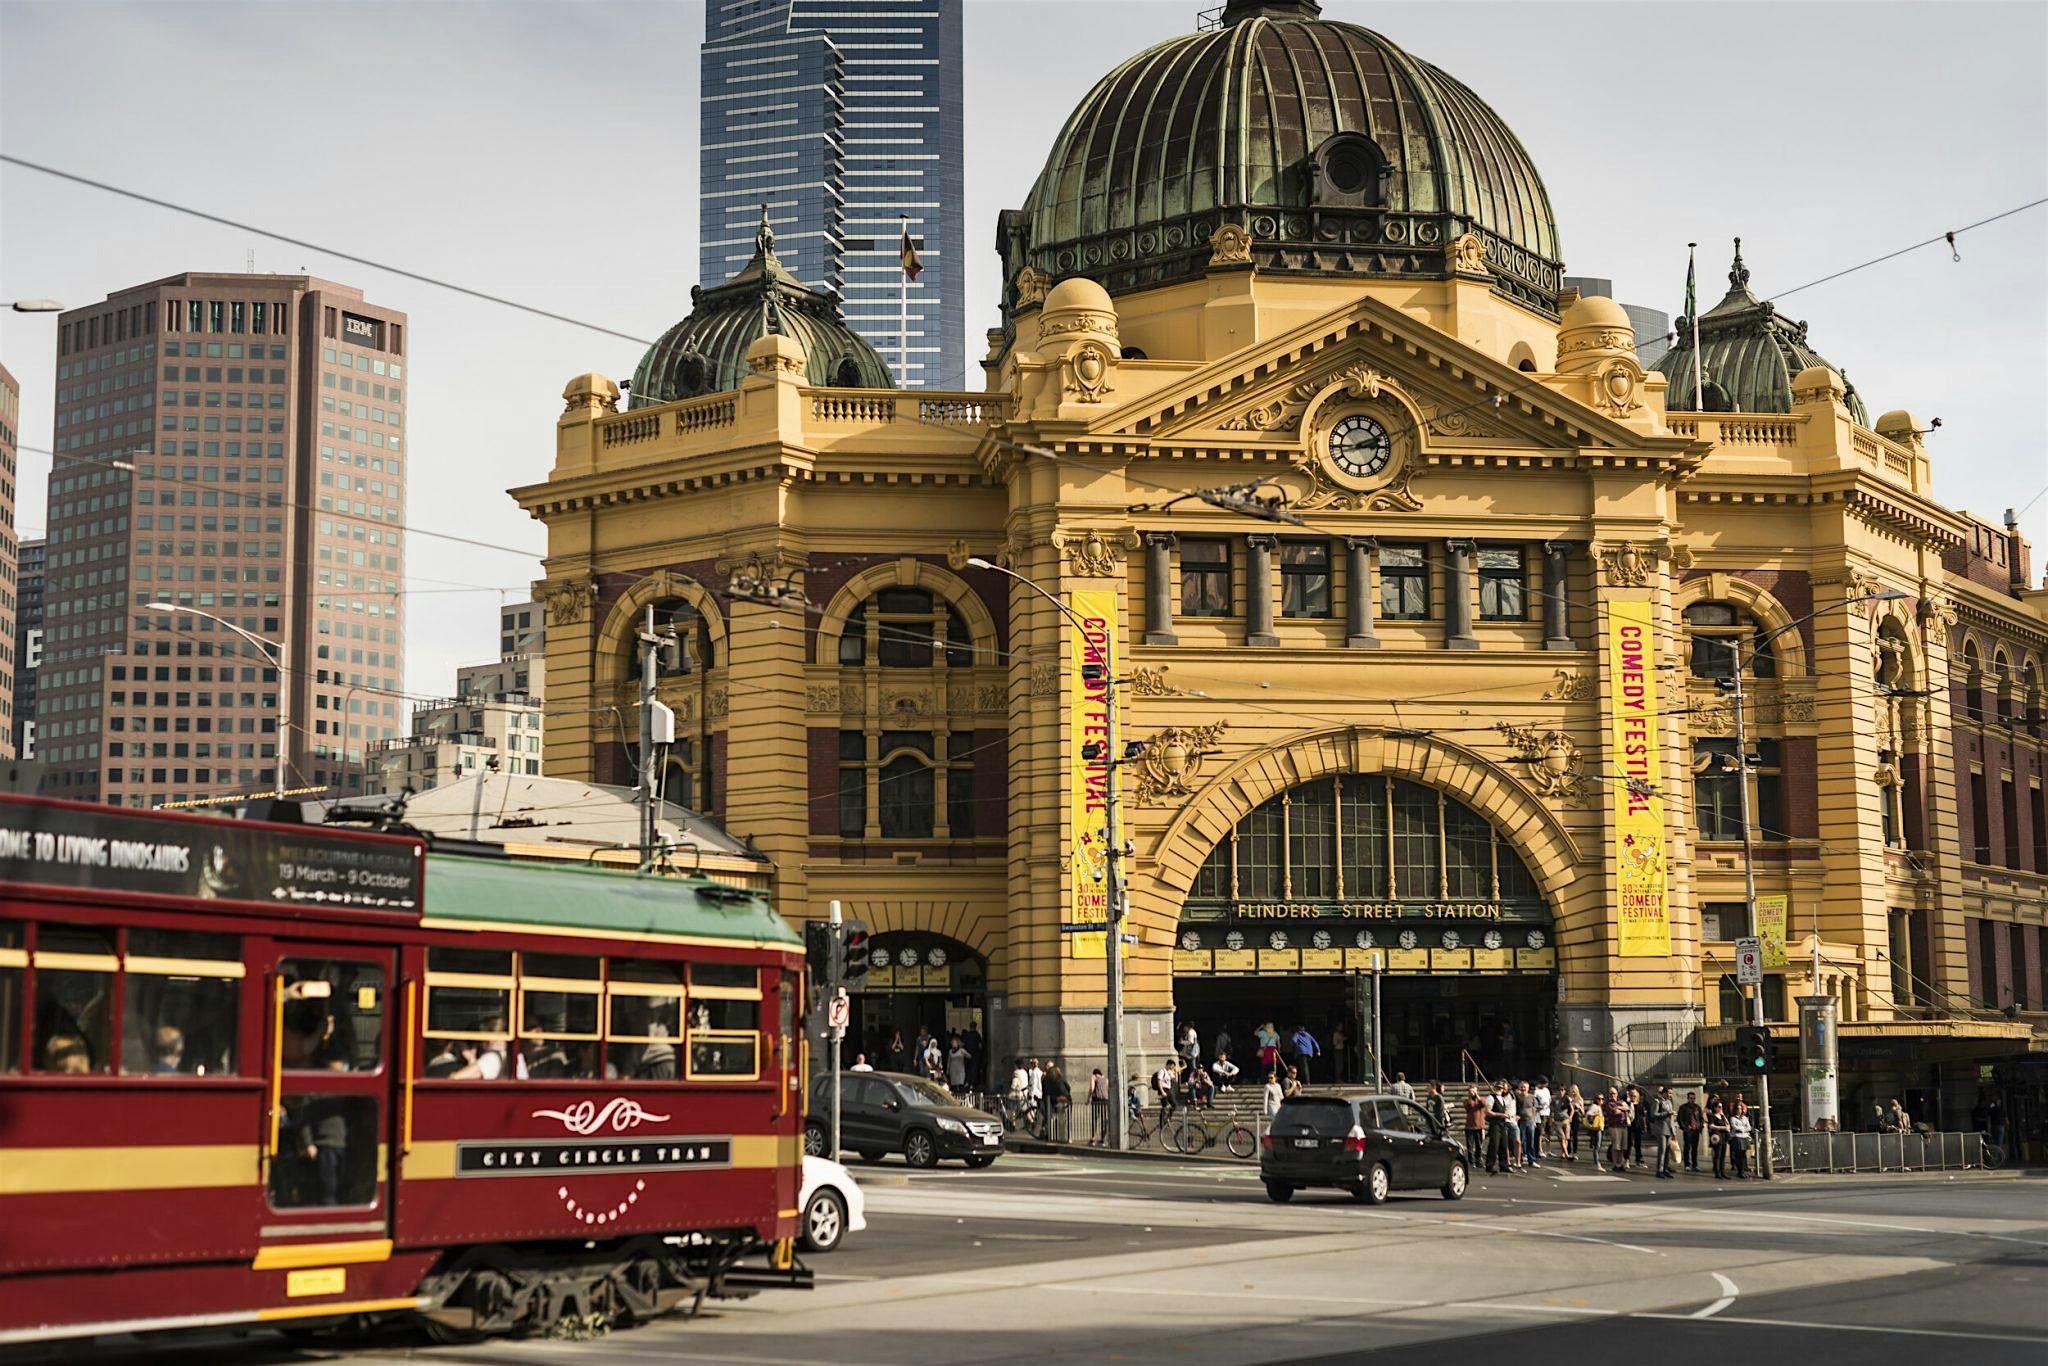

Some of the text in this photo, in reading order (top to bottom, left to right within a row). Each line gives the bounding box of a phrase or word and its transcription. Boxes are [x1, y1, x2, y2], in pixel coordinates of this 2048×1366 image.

[346, 318, 373, 337] IBM
[1620, 626, 1645, 710] COMEDY
[1083, 617, 1108, 813] COMDY FESIVAL
[34, 831, 56, 861] TO
[57, 834, 108, 867] LIVING
[110, 839, 190, 872] DINOSAURS
[279, 863, 294, 879] 19
[296, 864, 337, 882] March
[358, 869, 411, 889] October
[1077, 895, 1107, 906] COME
[1622, 895, 1663, 906] COMEDY
[1238, 904, 1500, 918] FLINDERS STREET STATION
[1623, 907, 1664, 918] FESTIVAL
[1760, 908, 1783, 916] COMEDY
[1760, 916, 1783, 924] FESTIVAL
[483, 1147, 711, 1166] CITY CIRCLE TRAM
